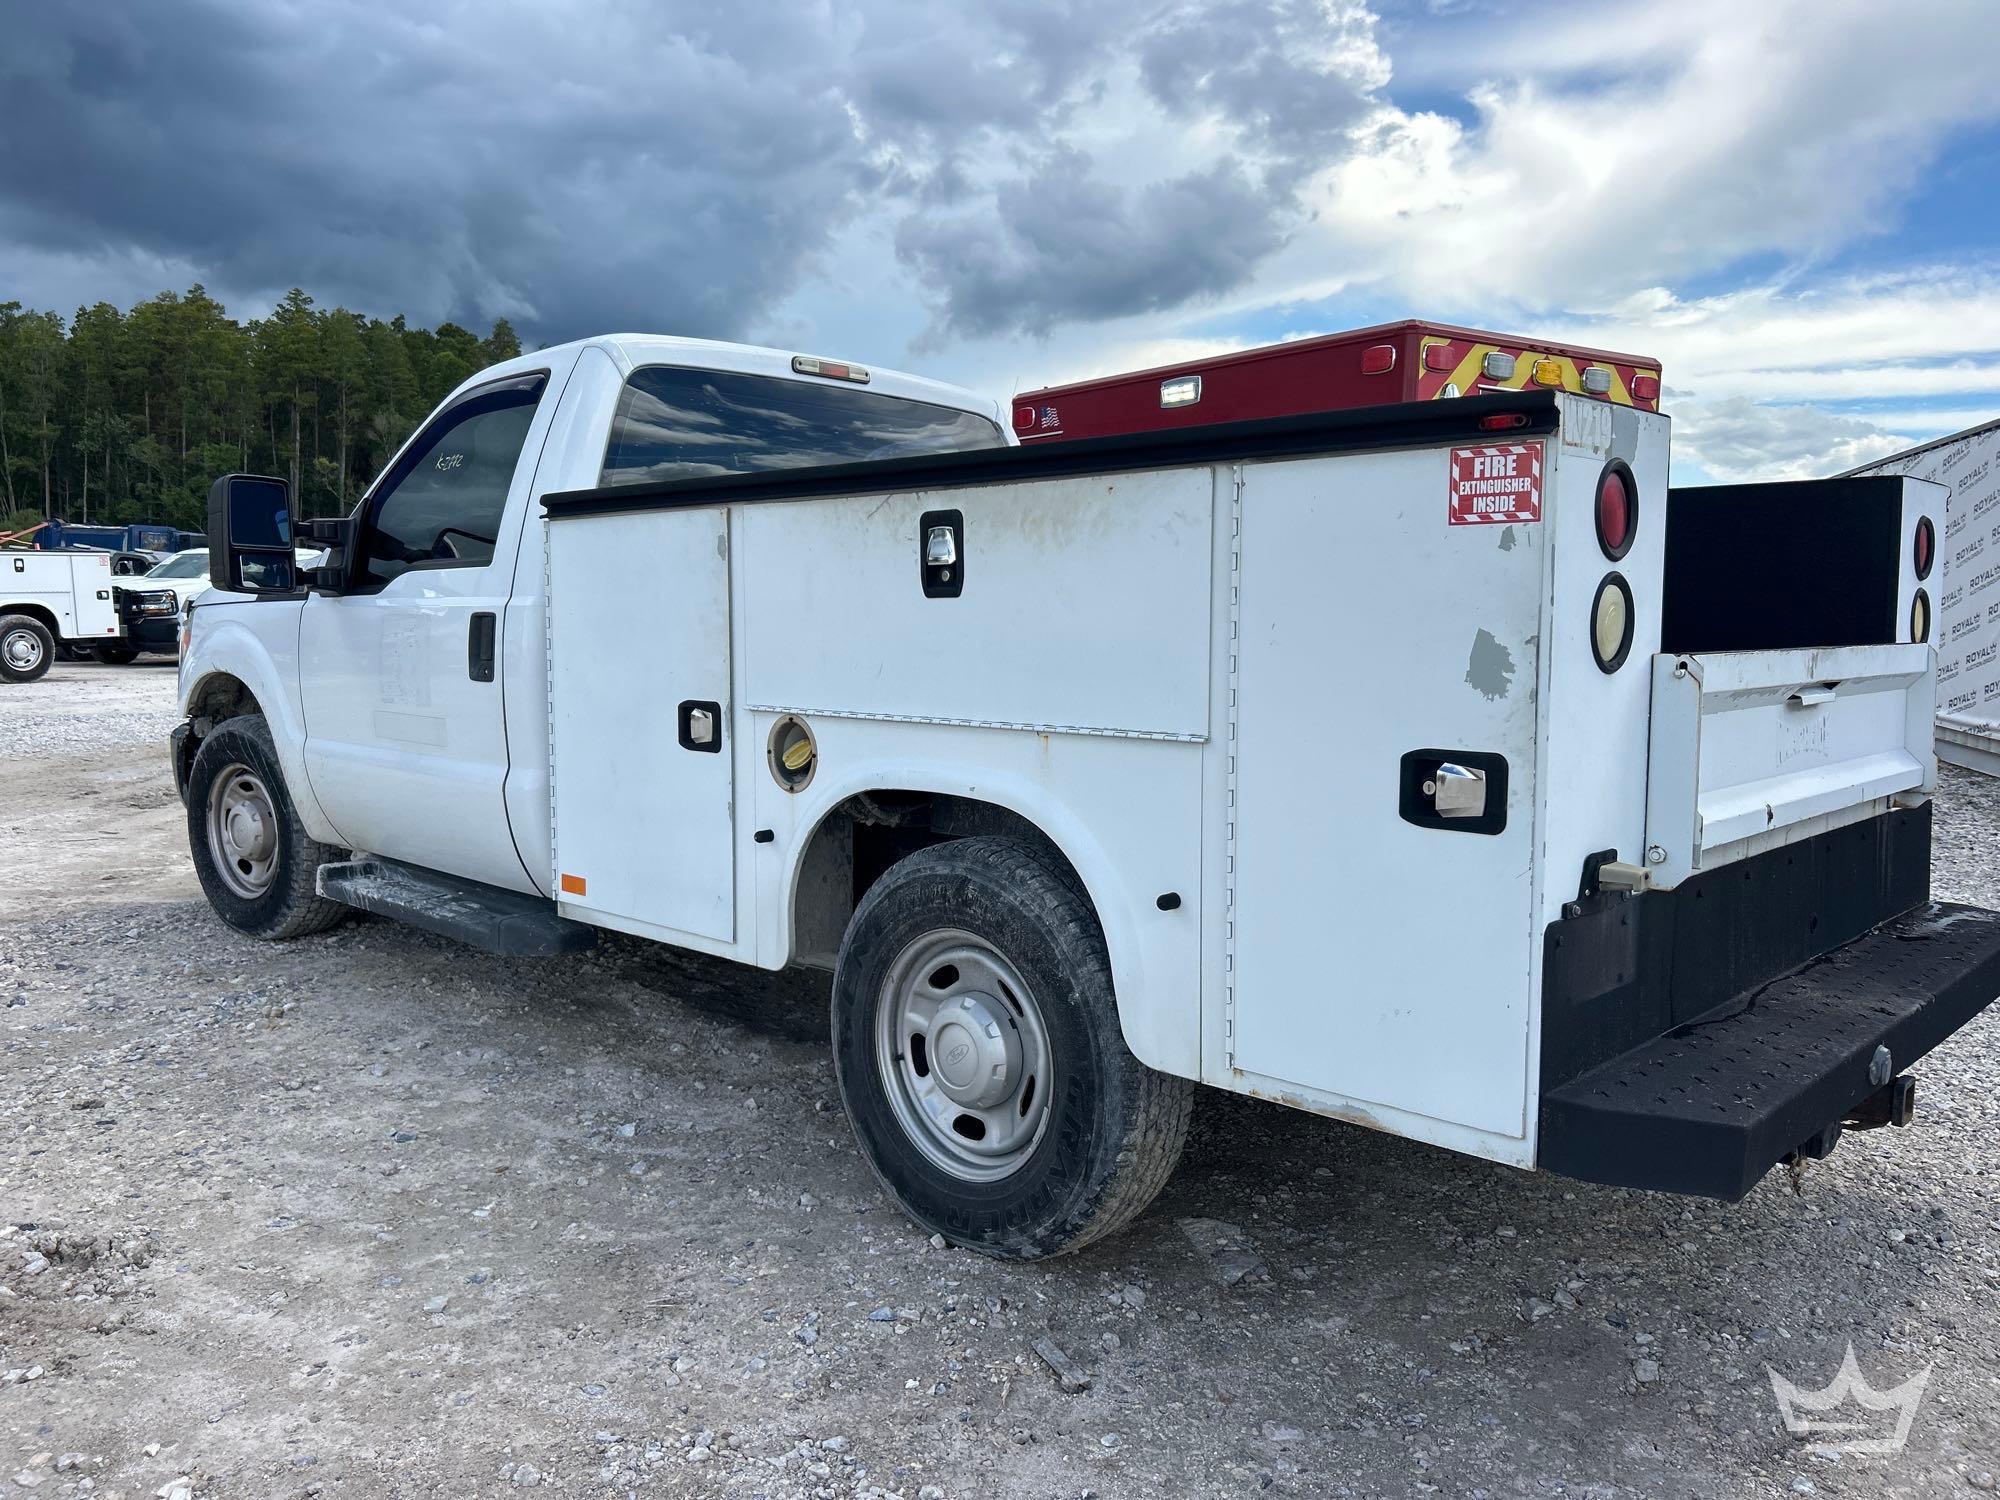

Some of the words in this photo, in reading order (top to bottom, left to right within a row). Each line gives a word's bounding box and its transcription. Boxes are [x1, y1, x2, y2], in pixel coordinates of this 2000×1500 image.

[1943, 445, 1964, 467] ROYAL
[1474, 455, 1517, 478] FIRE
[1460, 478, 1531, 495] EXTINGUISHER
[1959, 466, 1981, 488] ROYAL
[1473, 495, 1516, 513] INSIDE
[1974, 490, 1998, 513] ROYAL
[1956, 541, 1979, 561] ROYAL
[1970, 568, 1994, 588] ROYAL
[1952, 616, 1974, 635] ROYAL
[1966, 647, 1990, 664] ROYAL
[1937, 664, 1953, 677] OYAL
[1984, 680, 2000, 695] ROY
[1948, 692, 1970, 709] ROYAL
